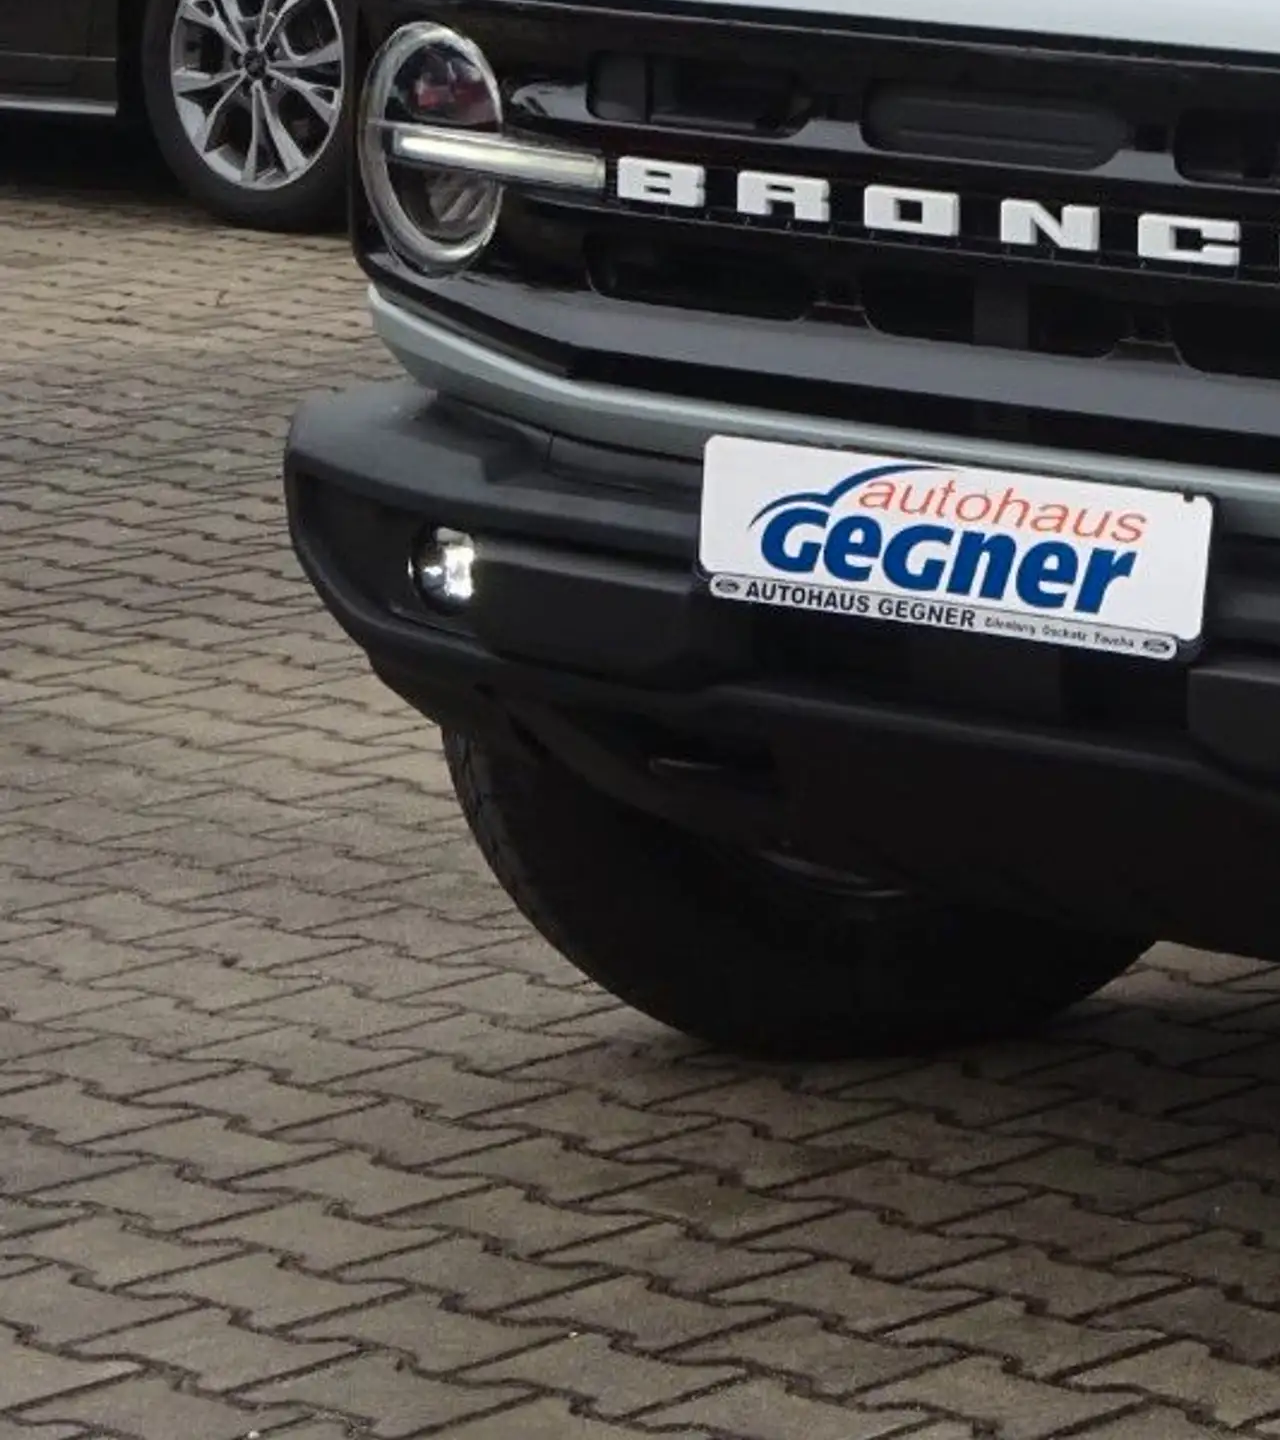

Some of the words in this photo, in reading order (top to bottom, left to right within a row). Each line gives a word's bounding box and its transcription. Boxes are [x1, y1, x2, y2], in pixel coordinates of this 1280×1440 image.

[857, 476, 1149, 545] autohaus
[745, 581, 870, 614] AUTOHAUS
[877, 597, 976, 628] GEGNER
